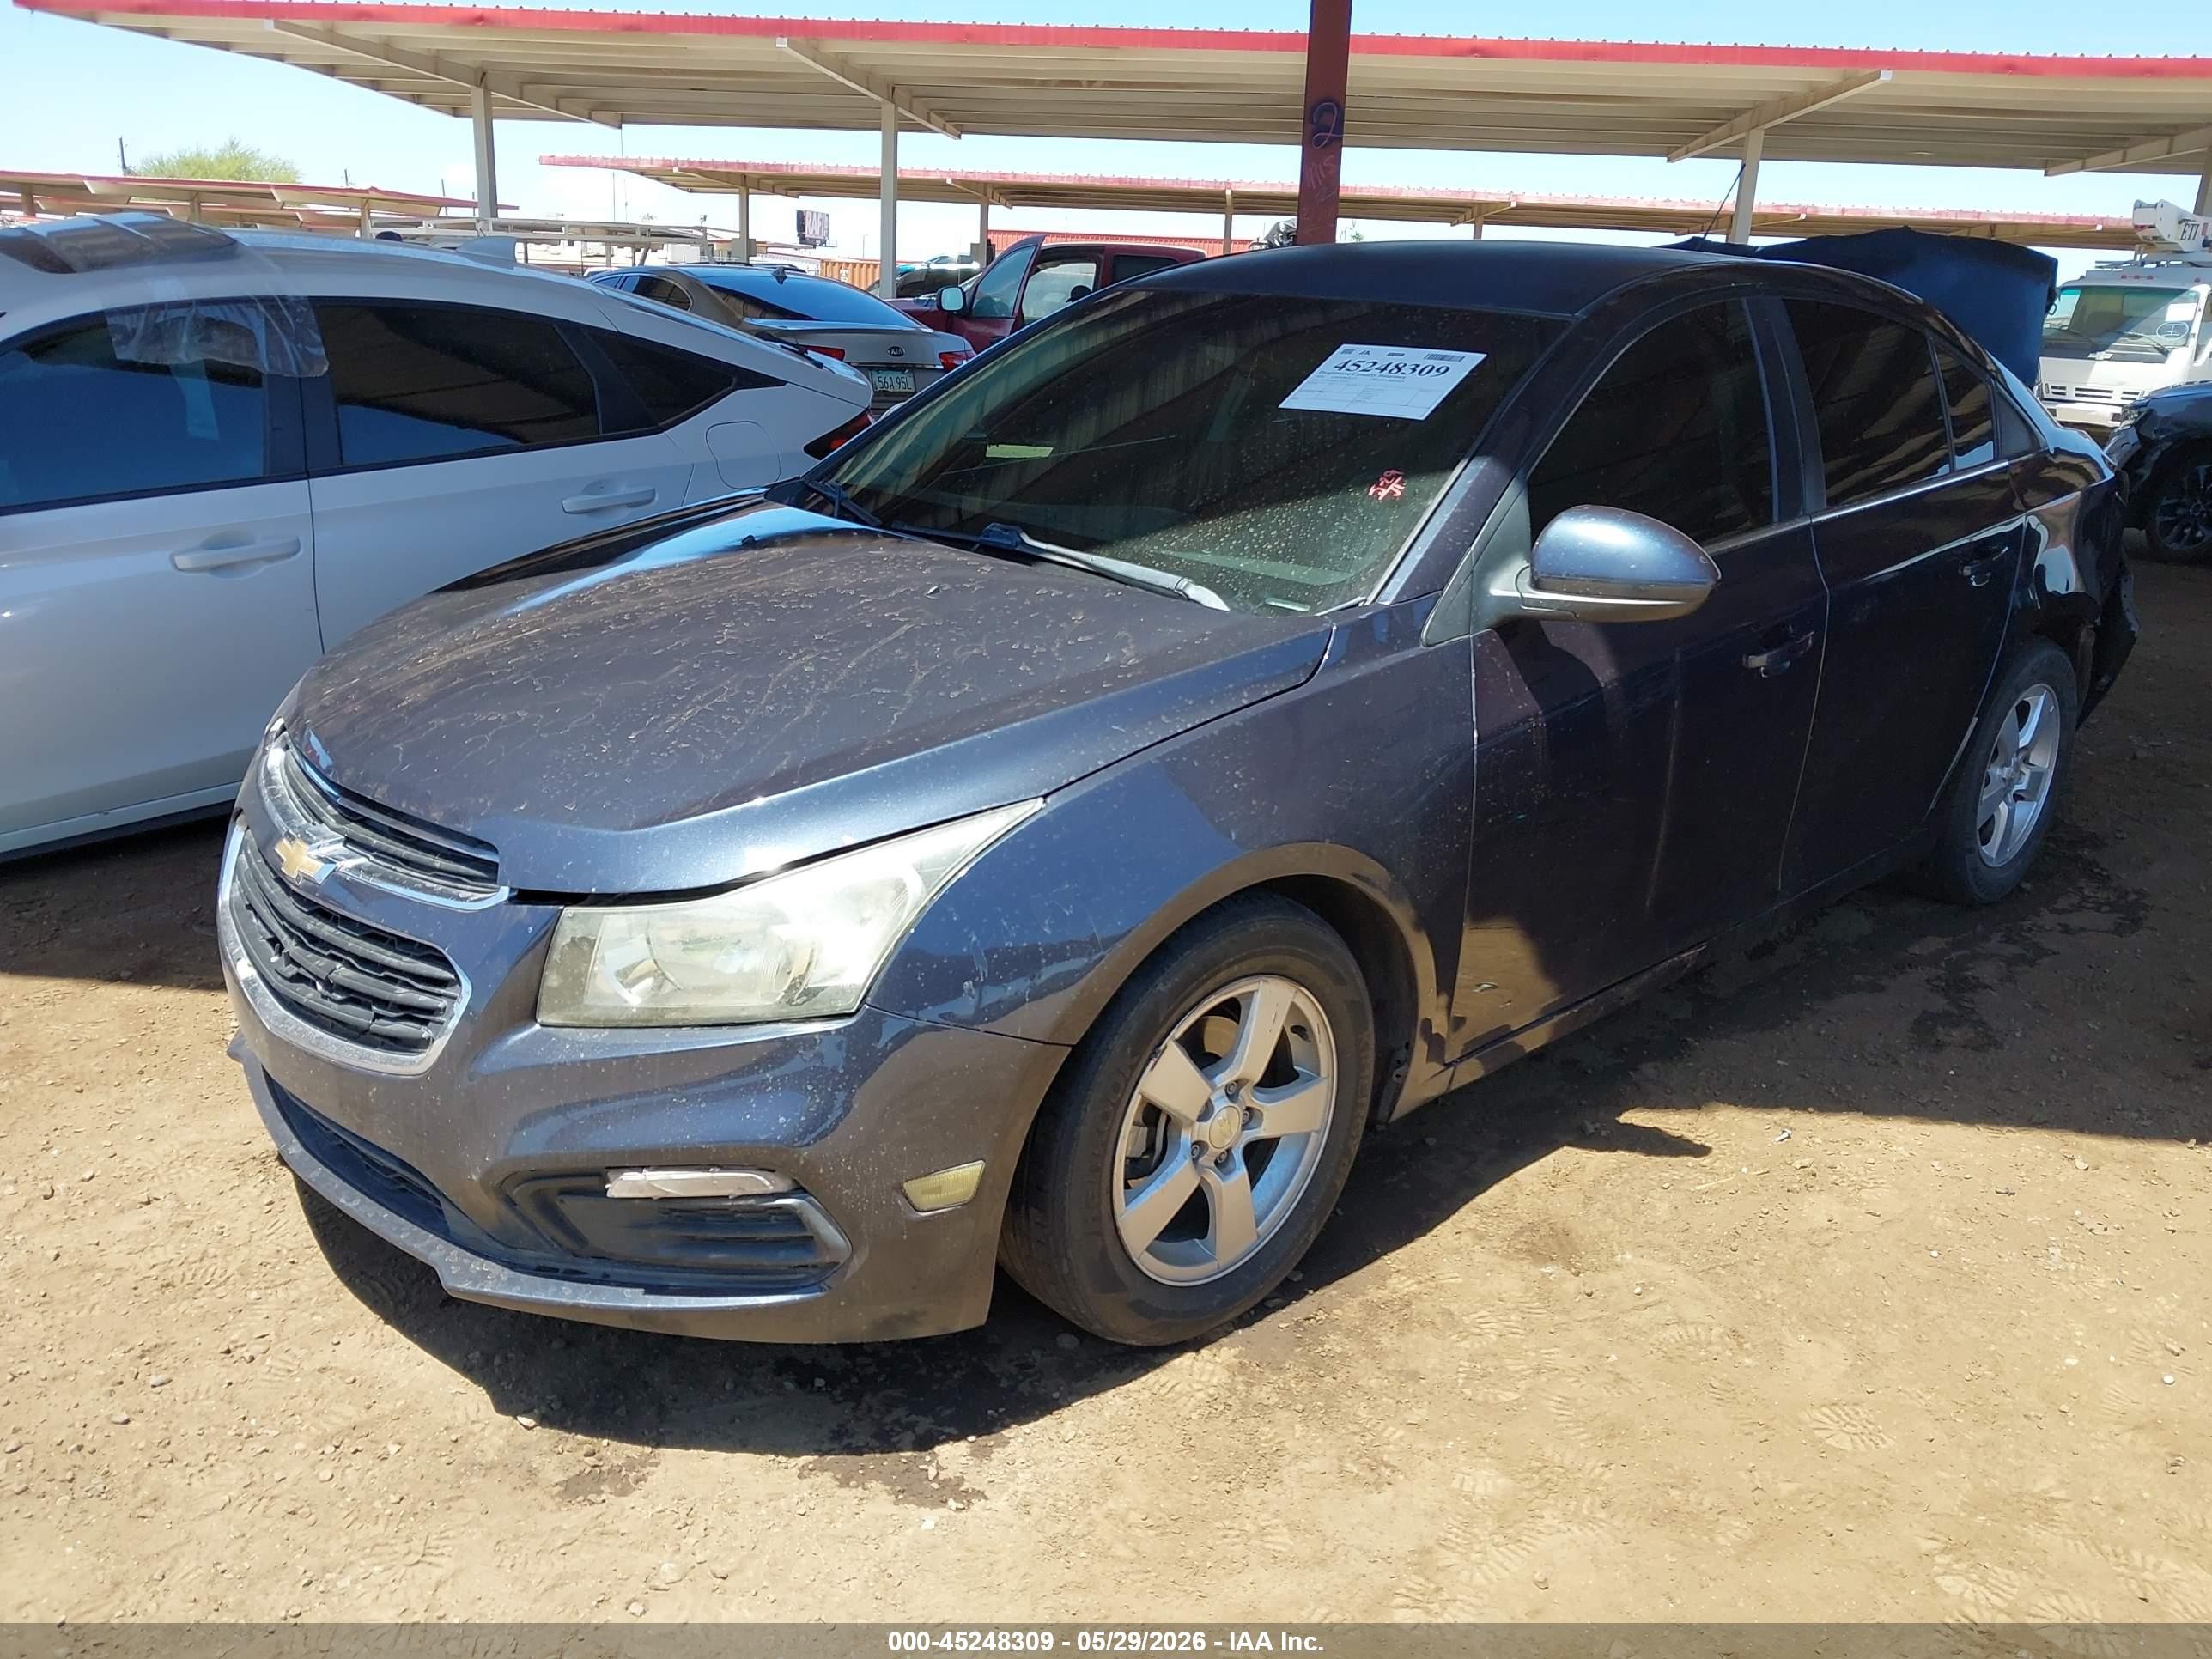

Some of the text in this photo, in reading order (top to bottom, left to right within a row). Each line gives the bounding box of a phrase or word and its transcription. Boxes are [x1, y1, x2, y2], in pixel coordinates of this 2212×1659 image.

[1312, 102, 1345, 149] 2
[2179, 223, 2200, 241] ETI
[1334, 359, 1450, 378] 45248309
[877, 376, 912, 390] 56A 95L
